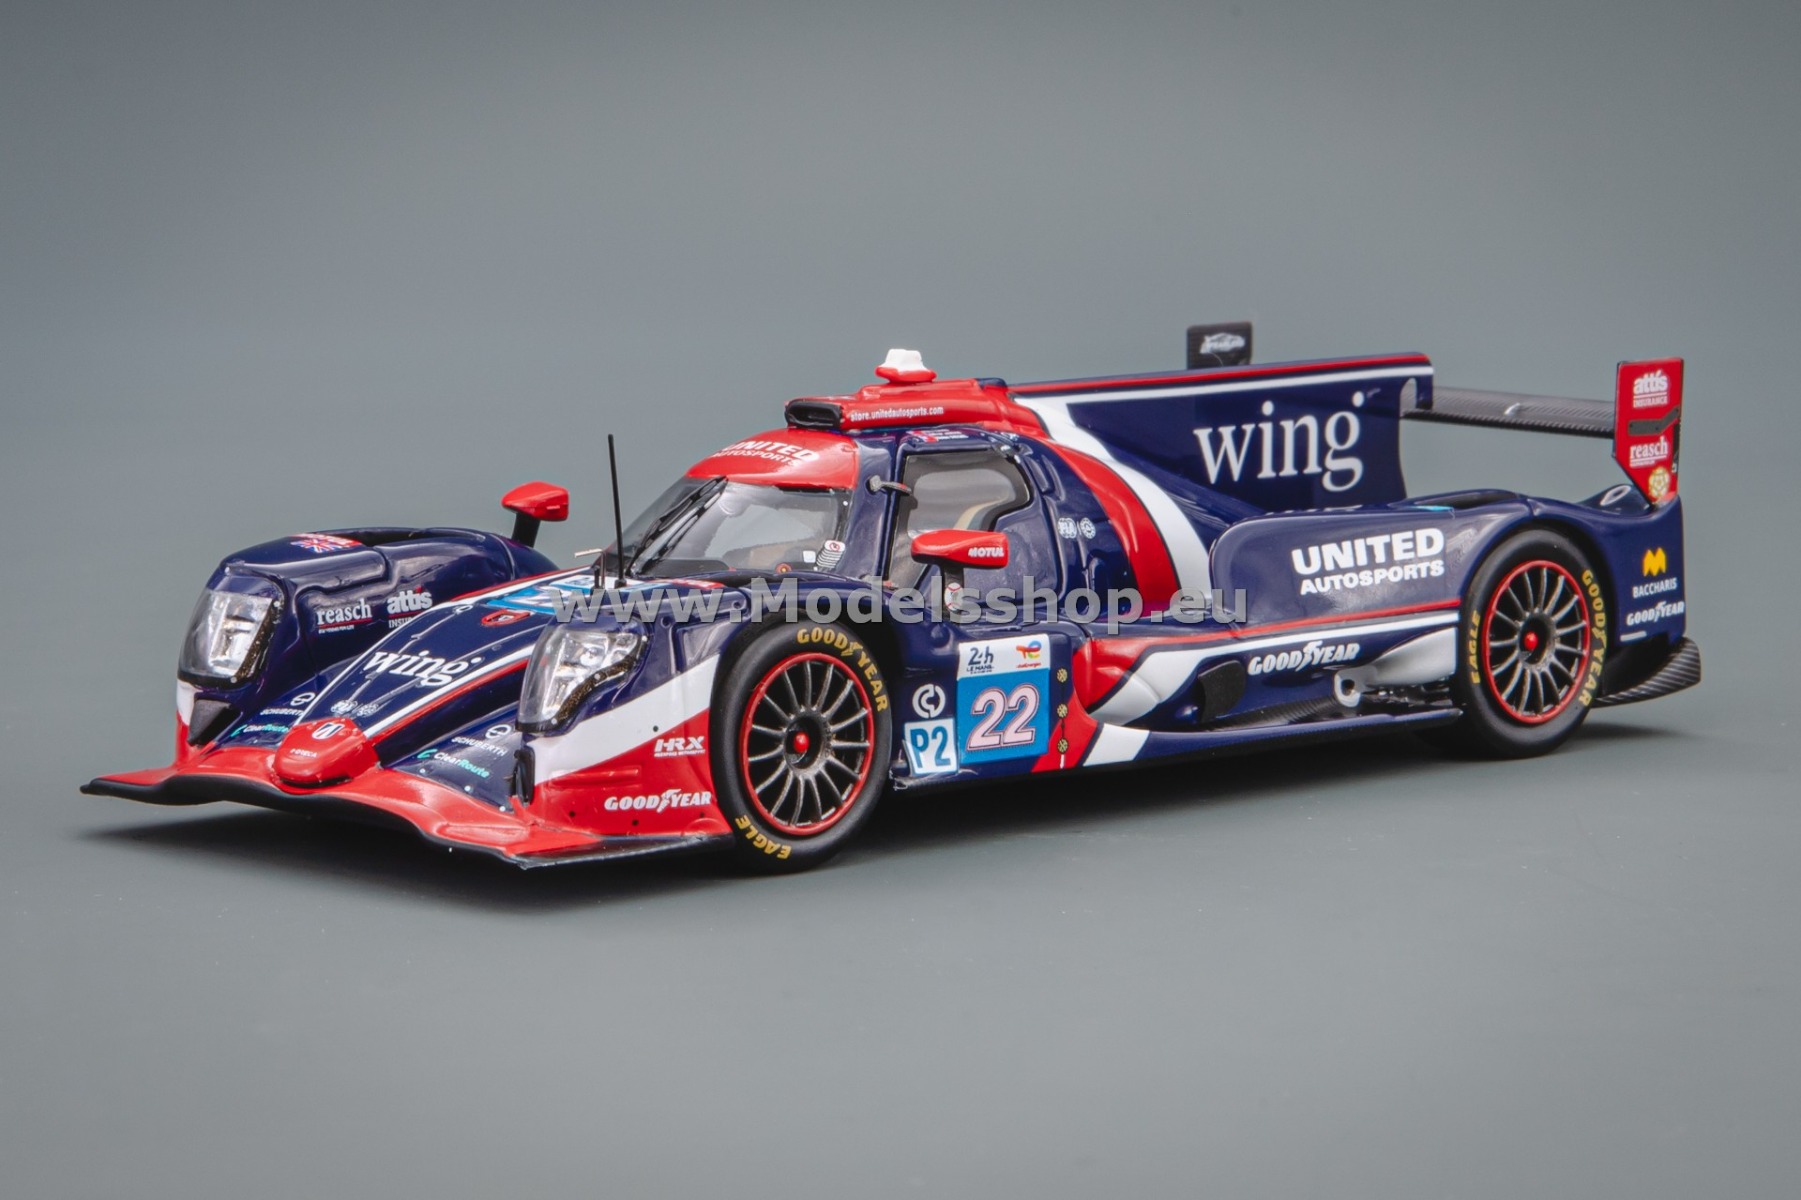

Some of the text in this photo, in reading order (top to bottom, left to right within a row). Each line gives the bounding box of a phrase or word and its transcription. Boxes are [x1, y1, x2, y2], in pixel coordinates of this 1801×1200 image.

[1193, 397, 1364, 492] wing
[1630, 436, 1668, 459] reasch
[968, 547, 1005, 557] MOTUL
[1291, 528, 1445, 575] UNITED
[1300, 559, 1446, 595] AUTOSPORTS
[1632, 577, 1678, 599] BACCHARIS
[316, 598, 373, 625] reasch
[363, 650, 479, 686] wing
[967, 684, 1040, 751] 22
[451, 737, 508, 756] SCHUBERTH
[654, 736, 704, 753] HRX
[910, 726, 951, 769] P2
[434, 752, 491, 778] ClearRoute
[735, 814, 792, 859] EAGLE
